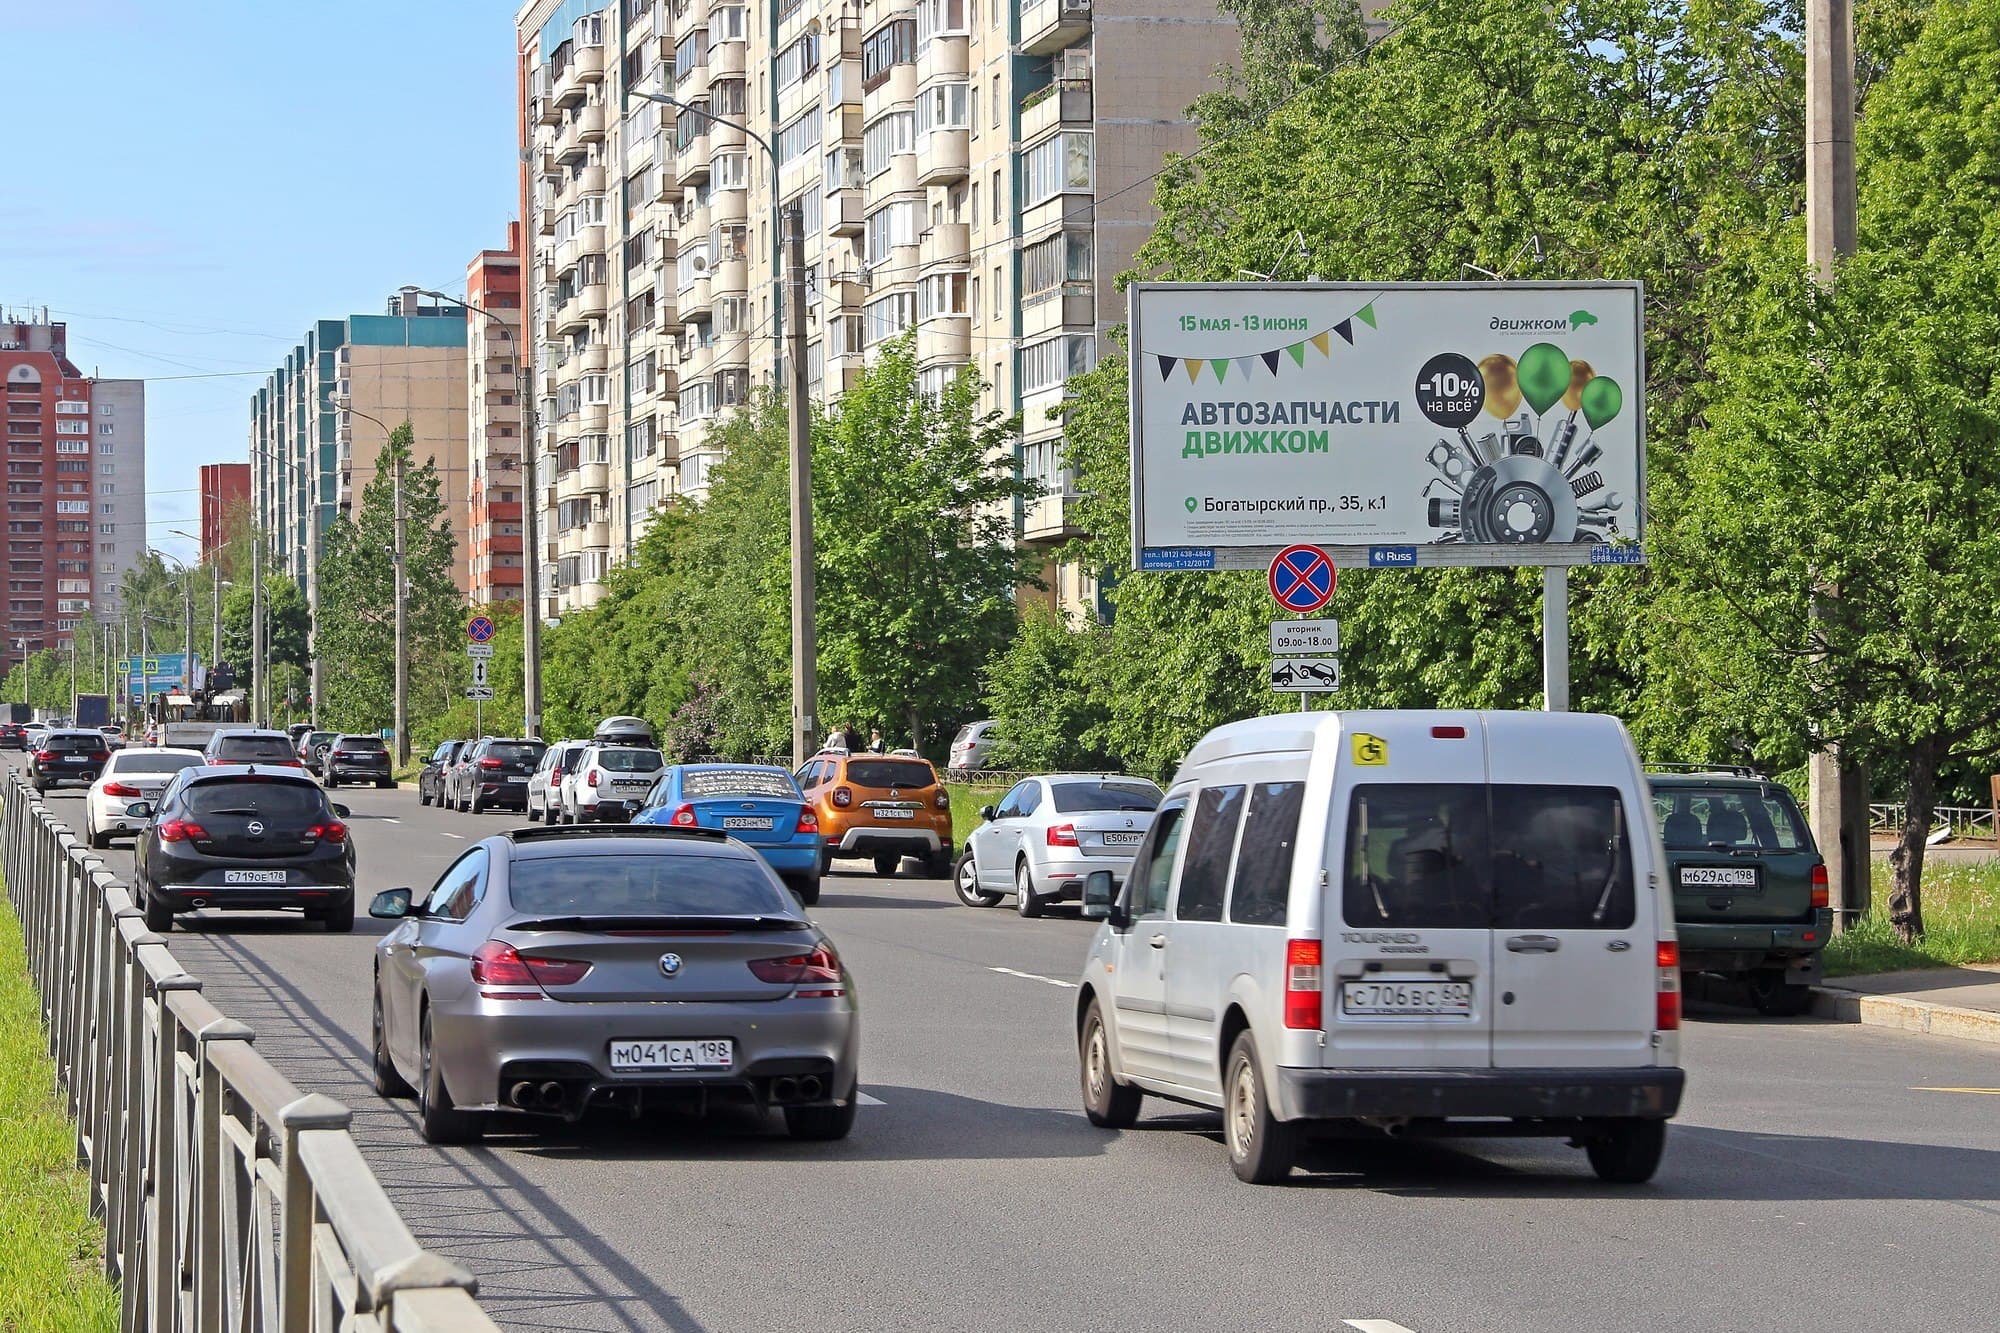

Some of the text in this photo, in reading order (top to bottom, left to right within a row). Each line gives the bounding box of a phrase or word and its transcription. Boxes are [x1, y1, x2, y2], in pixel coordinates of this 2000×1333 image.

[1179, 315, 1196, 331] 15
[1200, 318, 1231, 331] МАЯ
[1242, 315, 1260, 331] 13
[1263, 317, 1308, 331] ИЮНЯ
[1489, 316, 1567, 330] движком
[1420, 372, 1480, 397] -10%
[1427, 400, 1443, 412] на
[1181, 401, 1401, 426] АВТОЗАПЧАСТИ
[1182, 430, 1329, 459] ДВИЖКОМ
[1204, 496, 1387, 514] Богатырский пр., 35, к.1
[1161, 551, 1179, 559] (812)
[1386, 551, 1412, 561] Russ
[1144, 560, 1210, 569] договор: Т-12/2017
[1287, 626, 1322, 634] вторник
[1277, 636, 1332, 647] 09.00-18.00
